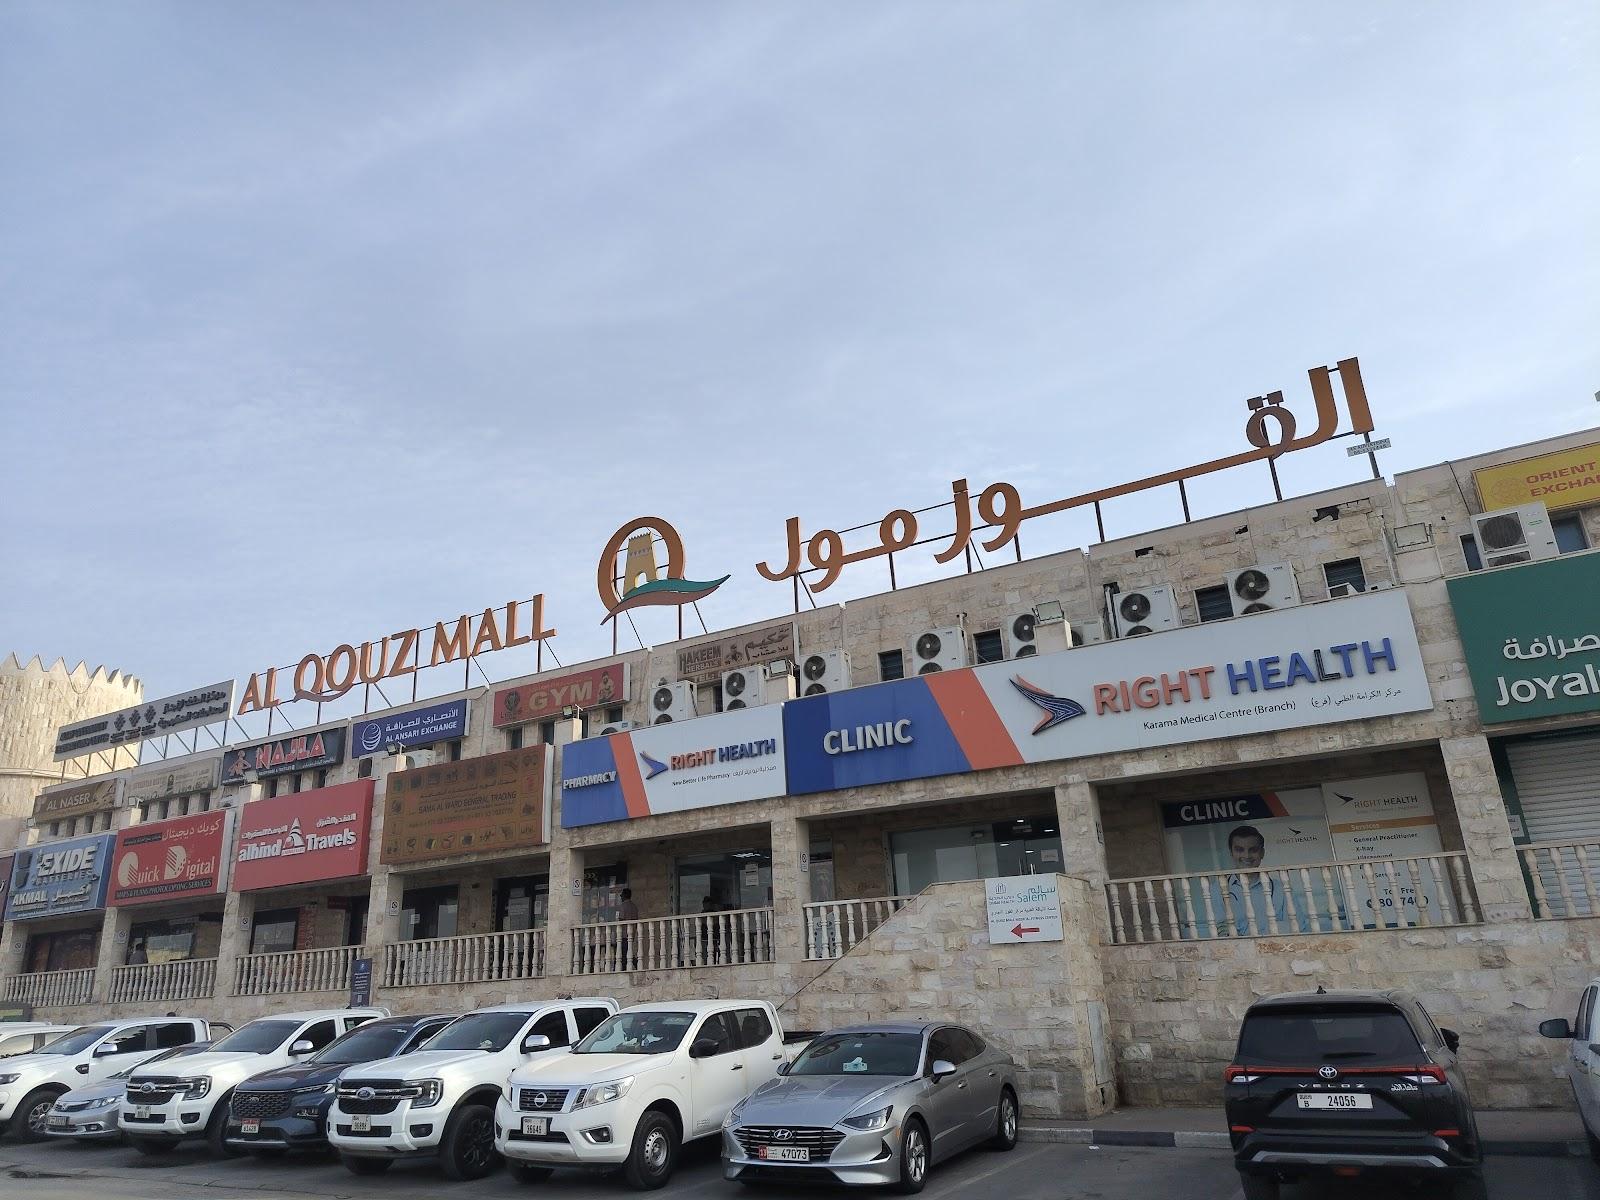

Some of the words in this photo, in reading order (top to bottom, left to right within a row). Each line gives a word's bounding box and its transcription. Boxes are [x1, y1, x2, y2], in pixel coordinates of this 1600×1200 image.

[1526, 461, 1596, 484] ORIENT
[756, 507, 919, 593] مول
[237, 667, 280, 715] AL
[292, 628, 418, 704] QOUZ
[430, 593, 557, 667] MALL
[679, 645, 722, 673] HAKEEM
[1092, 666, 1215, 716] RIGHT
[1226, 637, 1398, 696] HEALTH
[529, 679, 593, 711] GYM
[1334, 693, 1355, 707] الطبي
[1357, 689, 1382, 701] الكرامة
[1385, 689, 1401, 698] مركز
[422, 708, 459, 724] الأنصاري
[1143, 718, 1178, 730] Karama
[1180, 713, 1218, 726] Medical
[1219, 707, 1253, 720] Centre
[1254, 700, 1297, 717] (Branch)
[385, 717, 421, 732] للصرافة
[385, 735, 394, 743] AL
[395, 730, 419, 741] ANSARI
[421, 720, 458, 735] EXCHANGE
[823, 718, 914, 756] CLINIC
[256, 733, 326, 770] NAJLA
[670, 748, 716, 771] RIGHT
[718, 738, 776, 763] HEALTH
[563, 770, 617, 790] PHARMACY
[706, 772, 730, 782] Pharmacy
[47, 800, 57, 811] AL
[60, 792, 90, 808] NASER
[491, 791, 517, 802] TRADING
[1354, 798, 1382, 809] RIGHT
[1383, 795, 1419, 805] HEALTH
[1180, 799, 1250, 822] CLINIC
[162, 826, 195, 842] ديجيتال
[197, 818, 222, 836] كويك
[1351, 823, 1381, 831] Services
[305, 828, 357, 852] Travels
[1353, 835, 1379, 843] General
[1379, 832, 1419, 841] Practitioner
[37, 846, 97, 878] EXIDE
[12, 890, 49, 907] AKMAL
[1016, 893, 1047, 903] Salem
[1327, 1095, 1356, 1107] 24056
[781, 1149, 807, 1159] 47073
